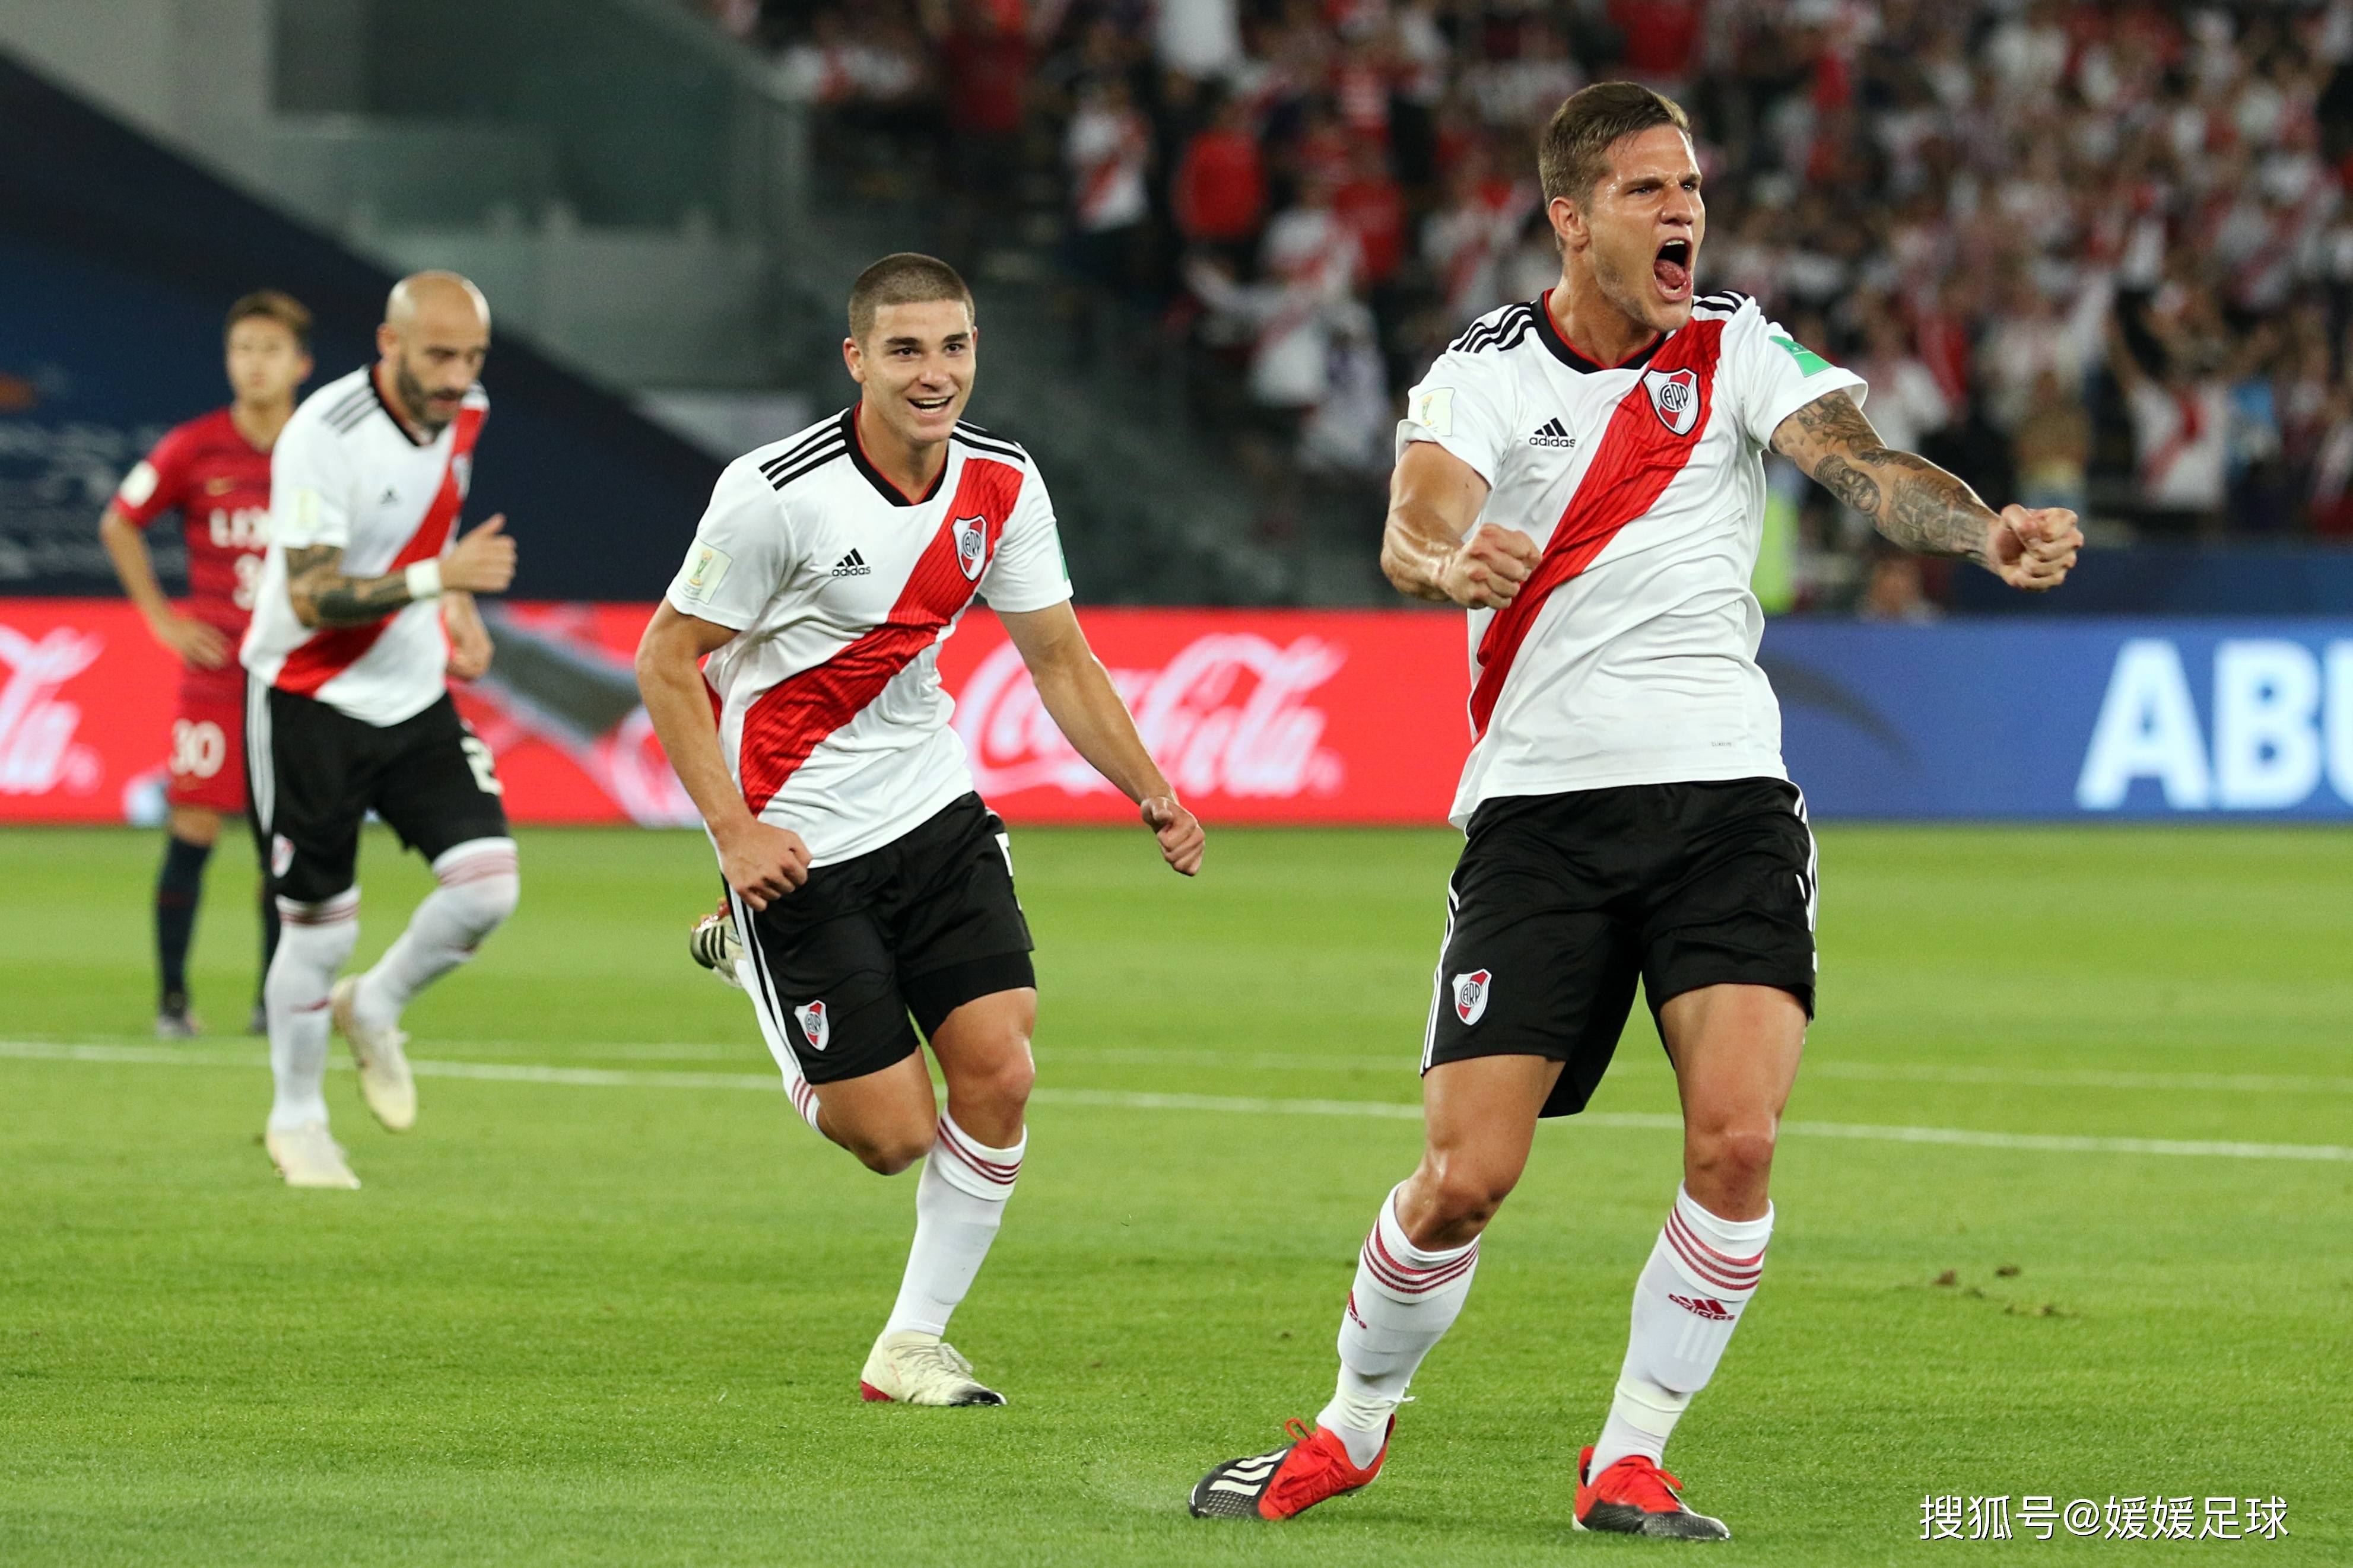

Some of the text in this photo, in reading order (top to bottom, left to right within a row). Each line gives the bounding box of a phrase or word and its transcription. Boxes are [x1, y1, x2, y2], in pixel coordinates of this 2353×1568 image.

[1529, 435, 1576, 448] adidas
[832, 565, 871, 577] adidas
[169, 718, 226, 778] 30
